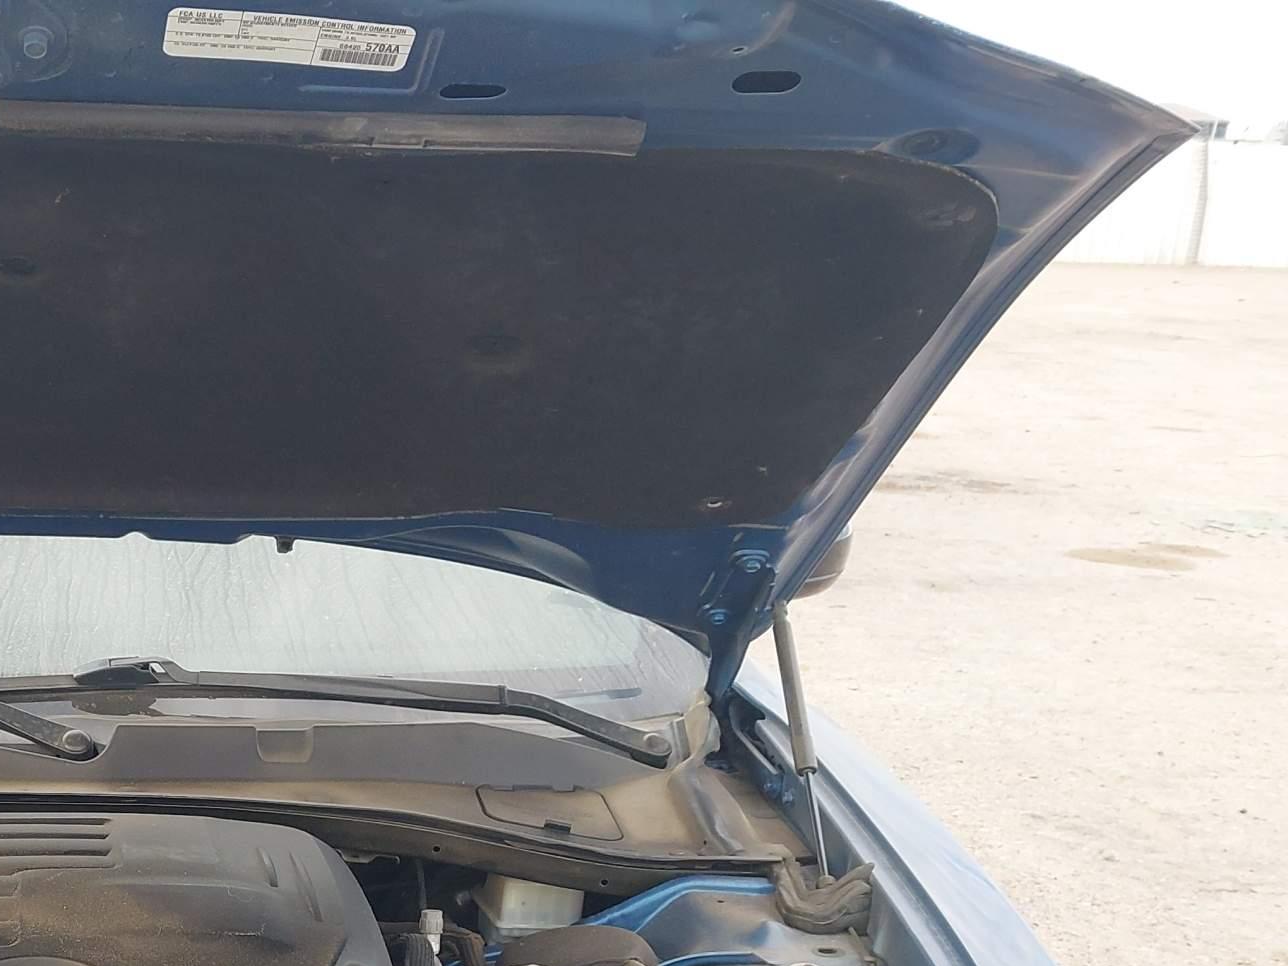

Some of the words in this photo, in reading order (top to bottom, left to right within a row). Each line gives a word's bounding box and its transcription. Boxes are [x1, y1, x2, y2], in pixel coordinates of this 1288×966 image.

[253, 15, 284, 24] VEHICLE
[285, 17, 320, 26] EMISSION
[321, 20, 354, 30] CONTROL
[357, 24, 408, 35] INFORMATION
[365, 42, 400, 54] 570AA
